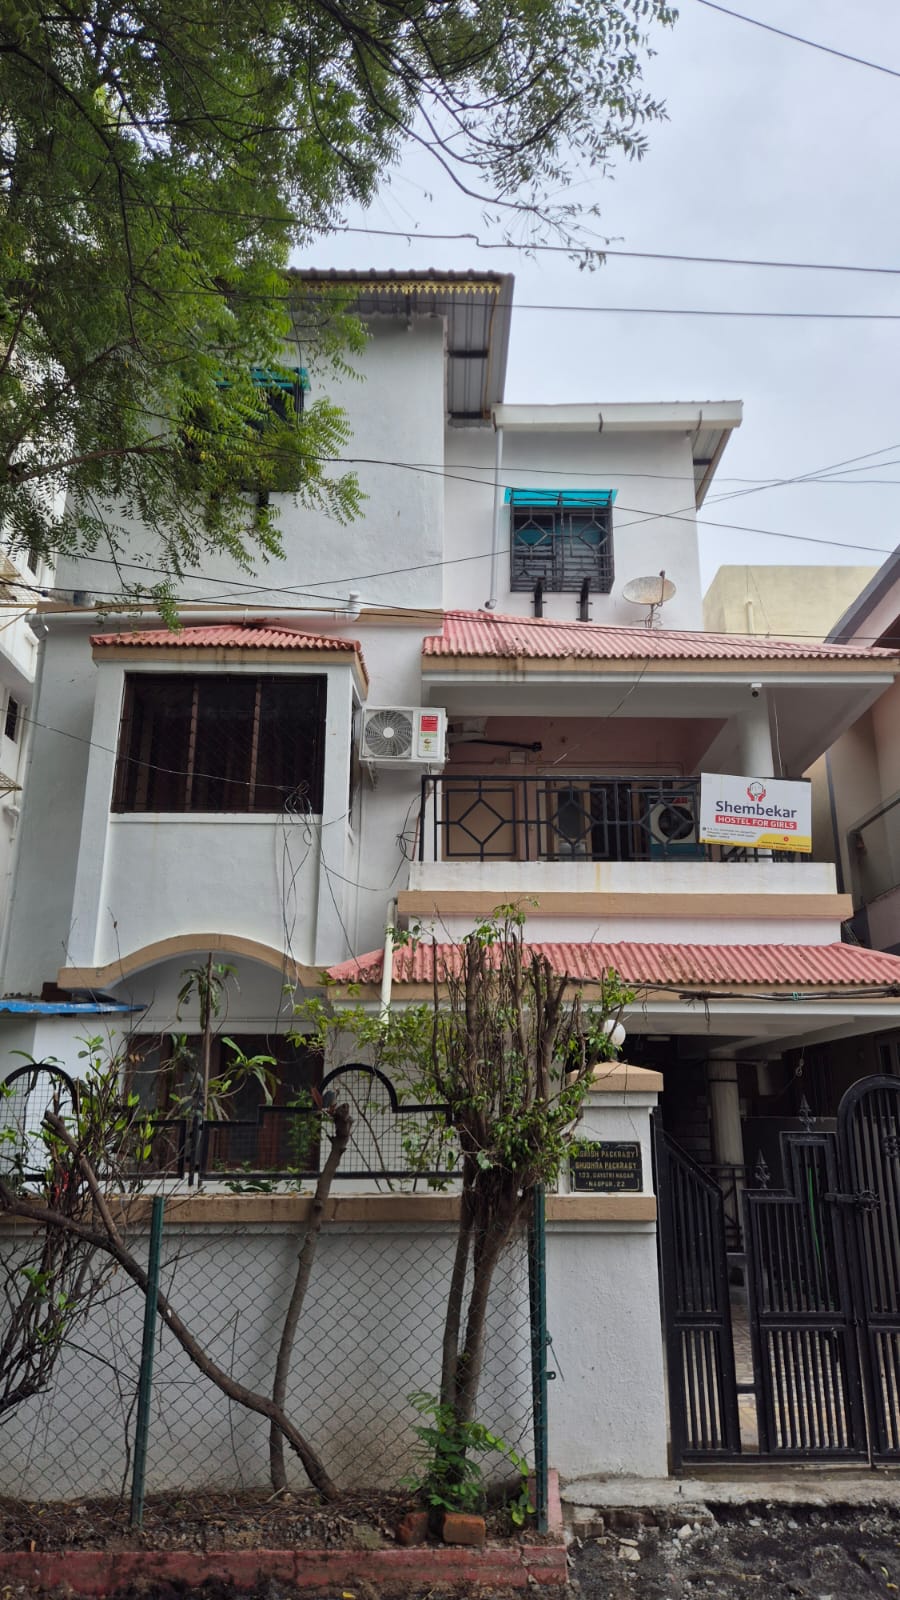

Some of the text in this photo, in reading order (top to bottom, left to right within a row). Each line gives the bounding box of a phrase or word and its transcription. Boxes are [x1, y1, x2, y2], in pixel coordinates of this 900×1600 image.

[716, 800, 797, 818] Shembekar
[717, 816, 794, 829] HOSTEL FOR GIRLS
